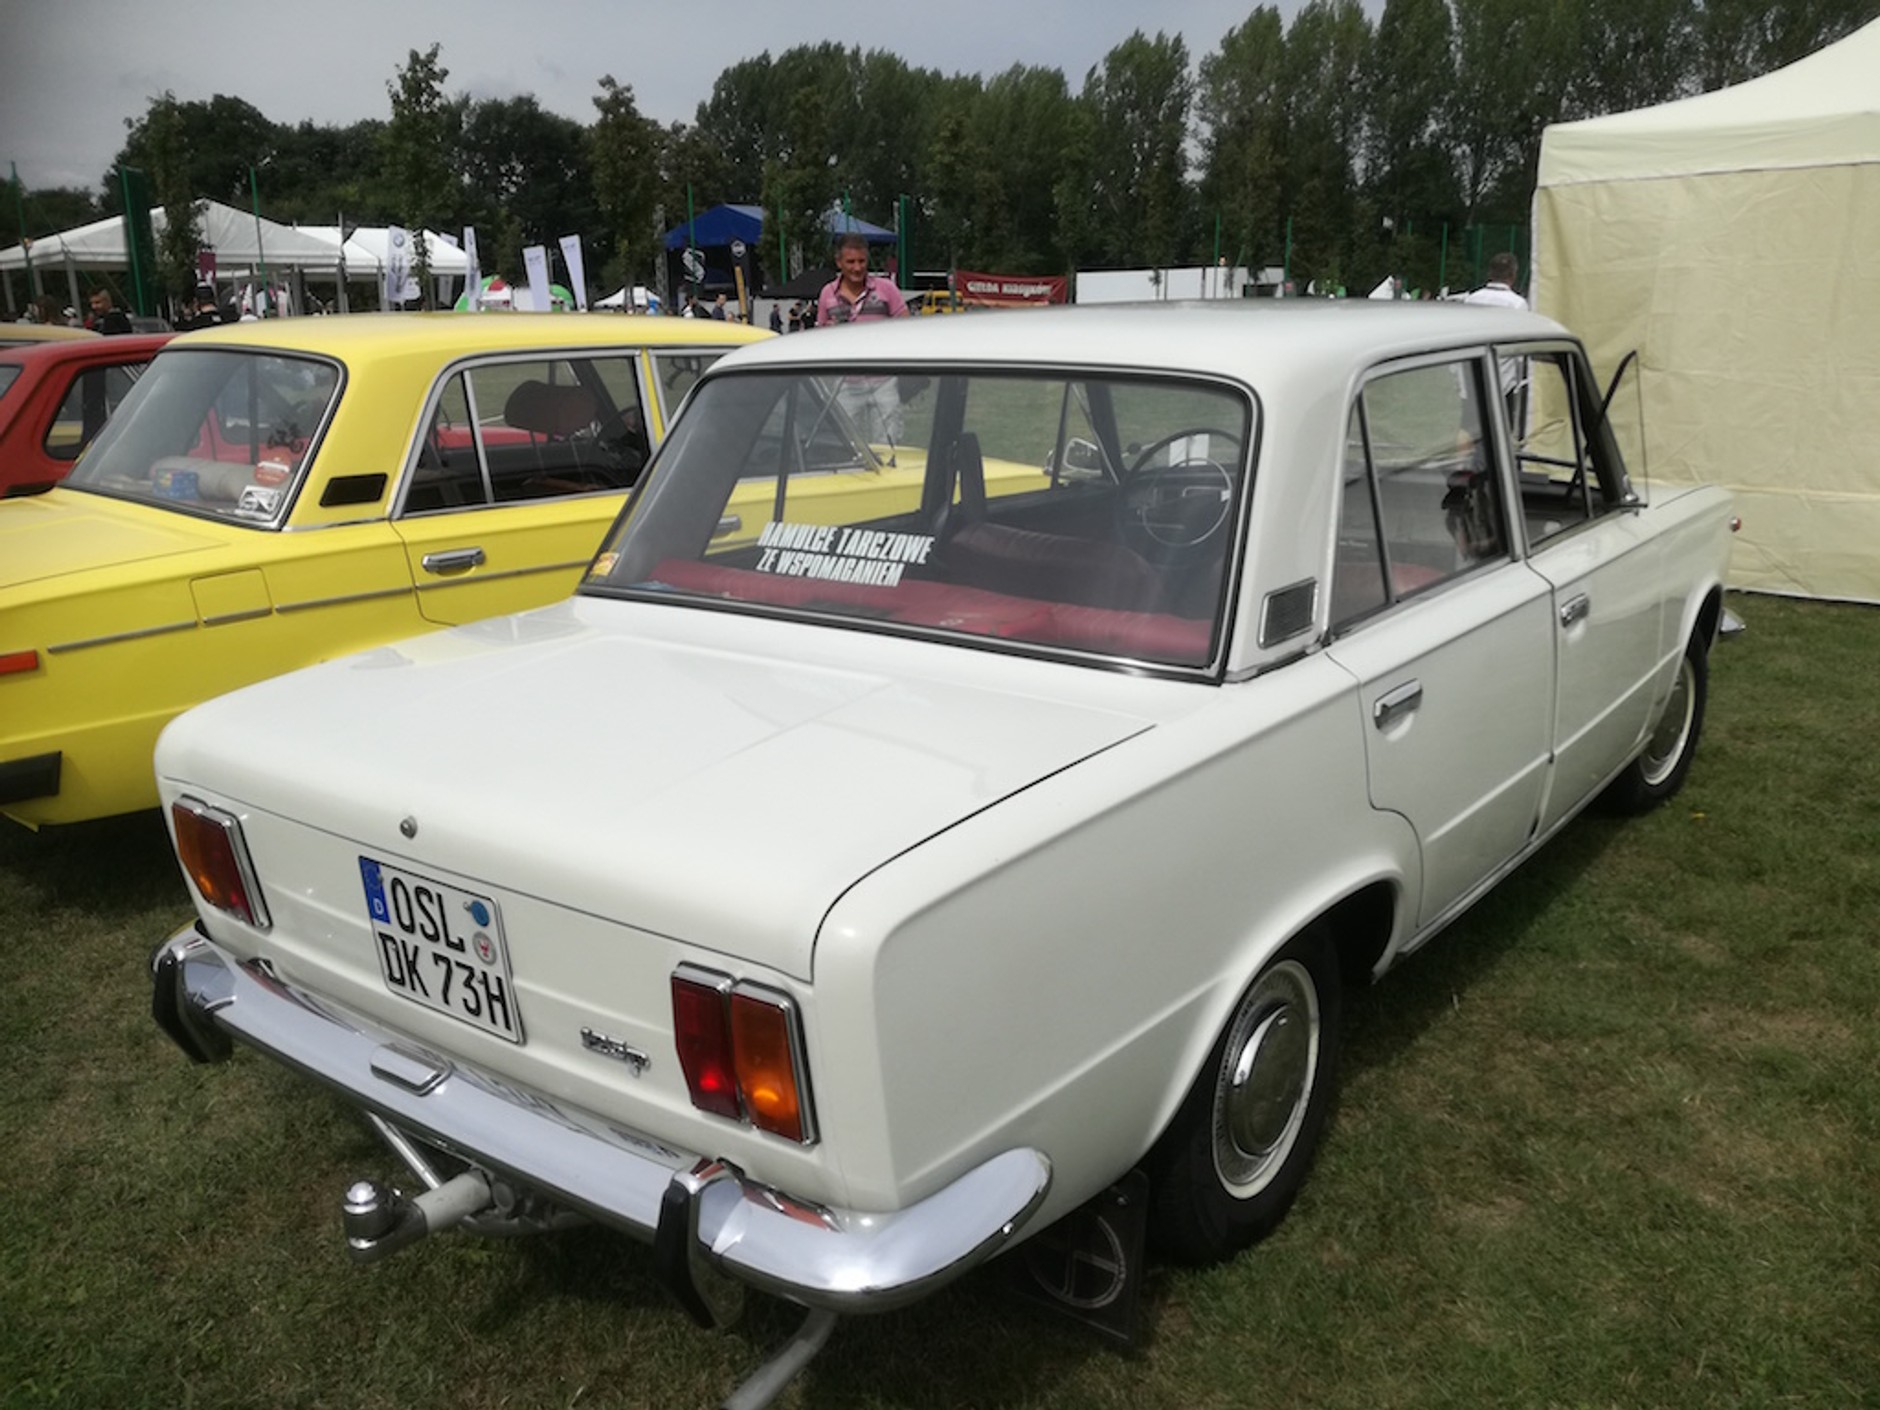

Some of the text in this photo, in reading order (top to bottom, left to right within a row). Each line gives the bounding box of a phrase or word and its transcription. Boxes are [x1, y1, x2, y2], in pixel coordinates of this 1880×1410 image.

[757, 521, 935, 565] HAMULCE TARCZOWE
[756, 548, 905, 588] ZE WSPOMAGANIEM
[373, 898, 384, 915] D
[391, 877, 466, 953] OSL
[378, 932, 512, 1031] DK 73H
